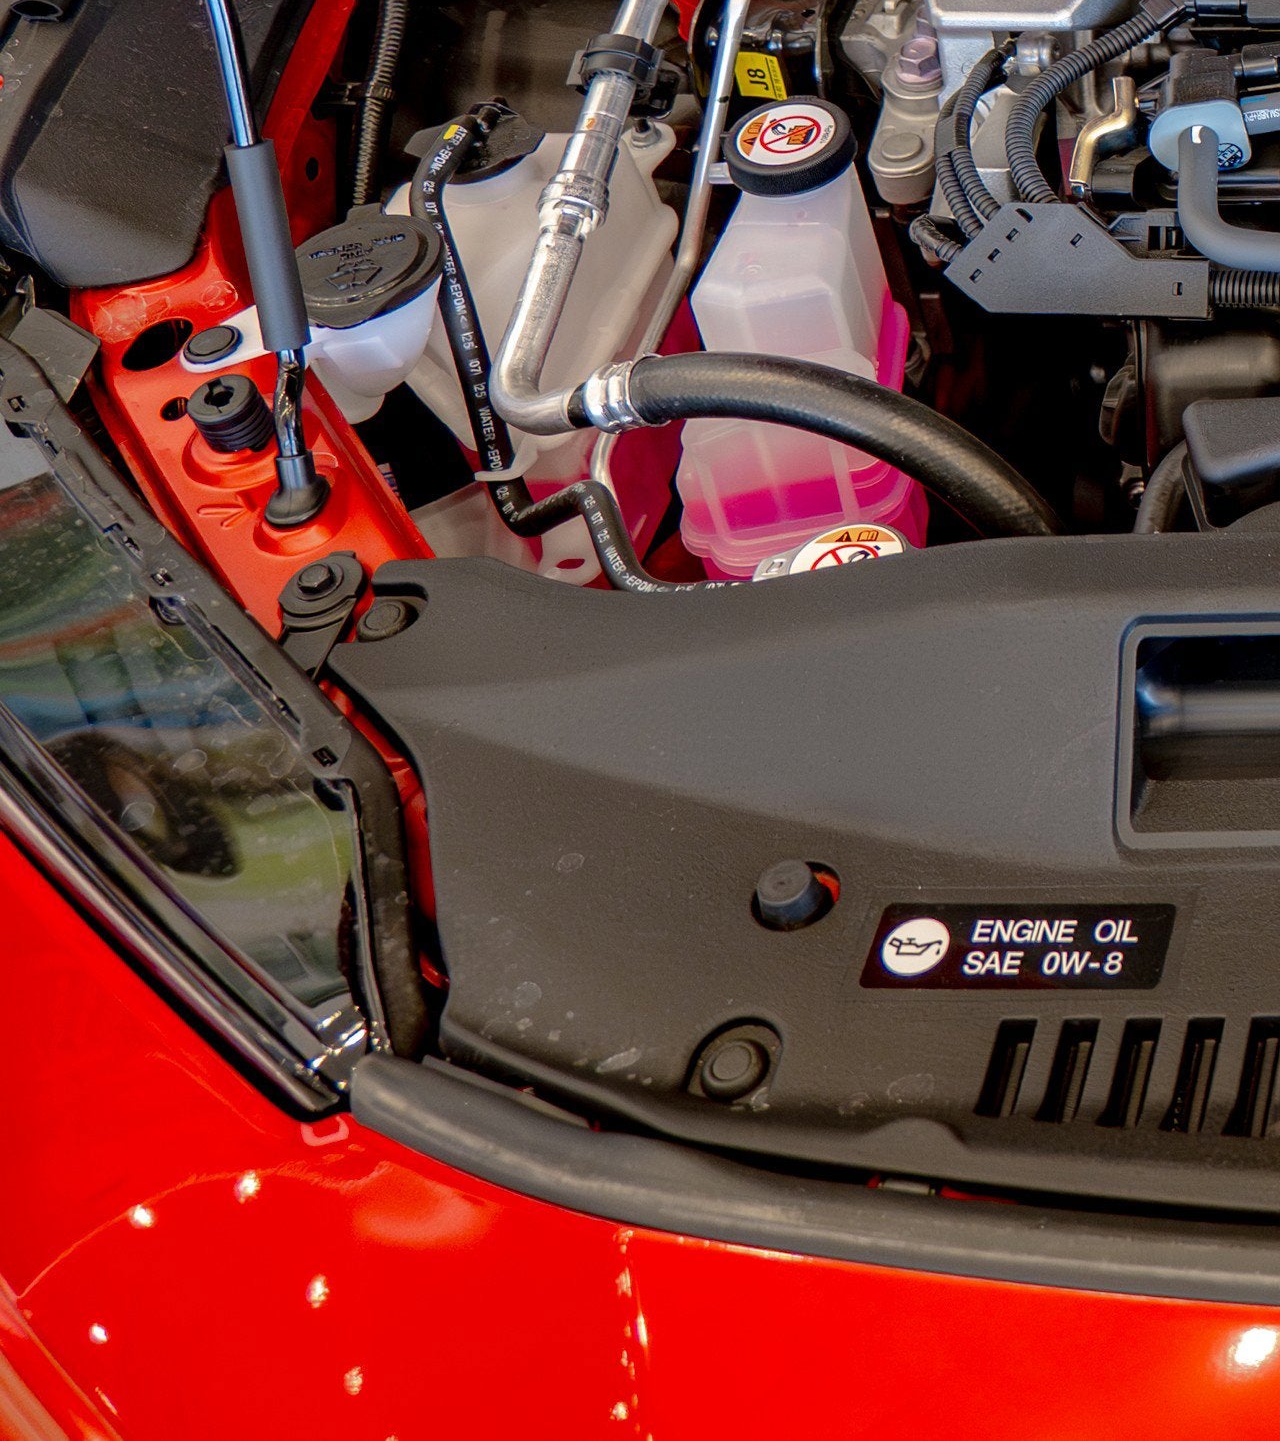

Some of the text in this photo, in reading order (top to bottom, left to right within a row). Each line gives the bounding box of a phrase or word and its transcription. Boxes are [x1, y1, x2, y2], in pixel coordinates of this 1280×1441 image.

[747, 68, 769, 91] J8
[452, 125, 468, 146] ATER
[478, 405, 496, 442] WATER
[604, 544, 627, 576] WATER
[970, 919, 1138, 943] ENGINE OIL
[962, 951, 1123, 976] SAE 0W-8
